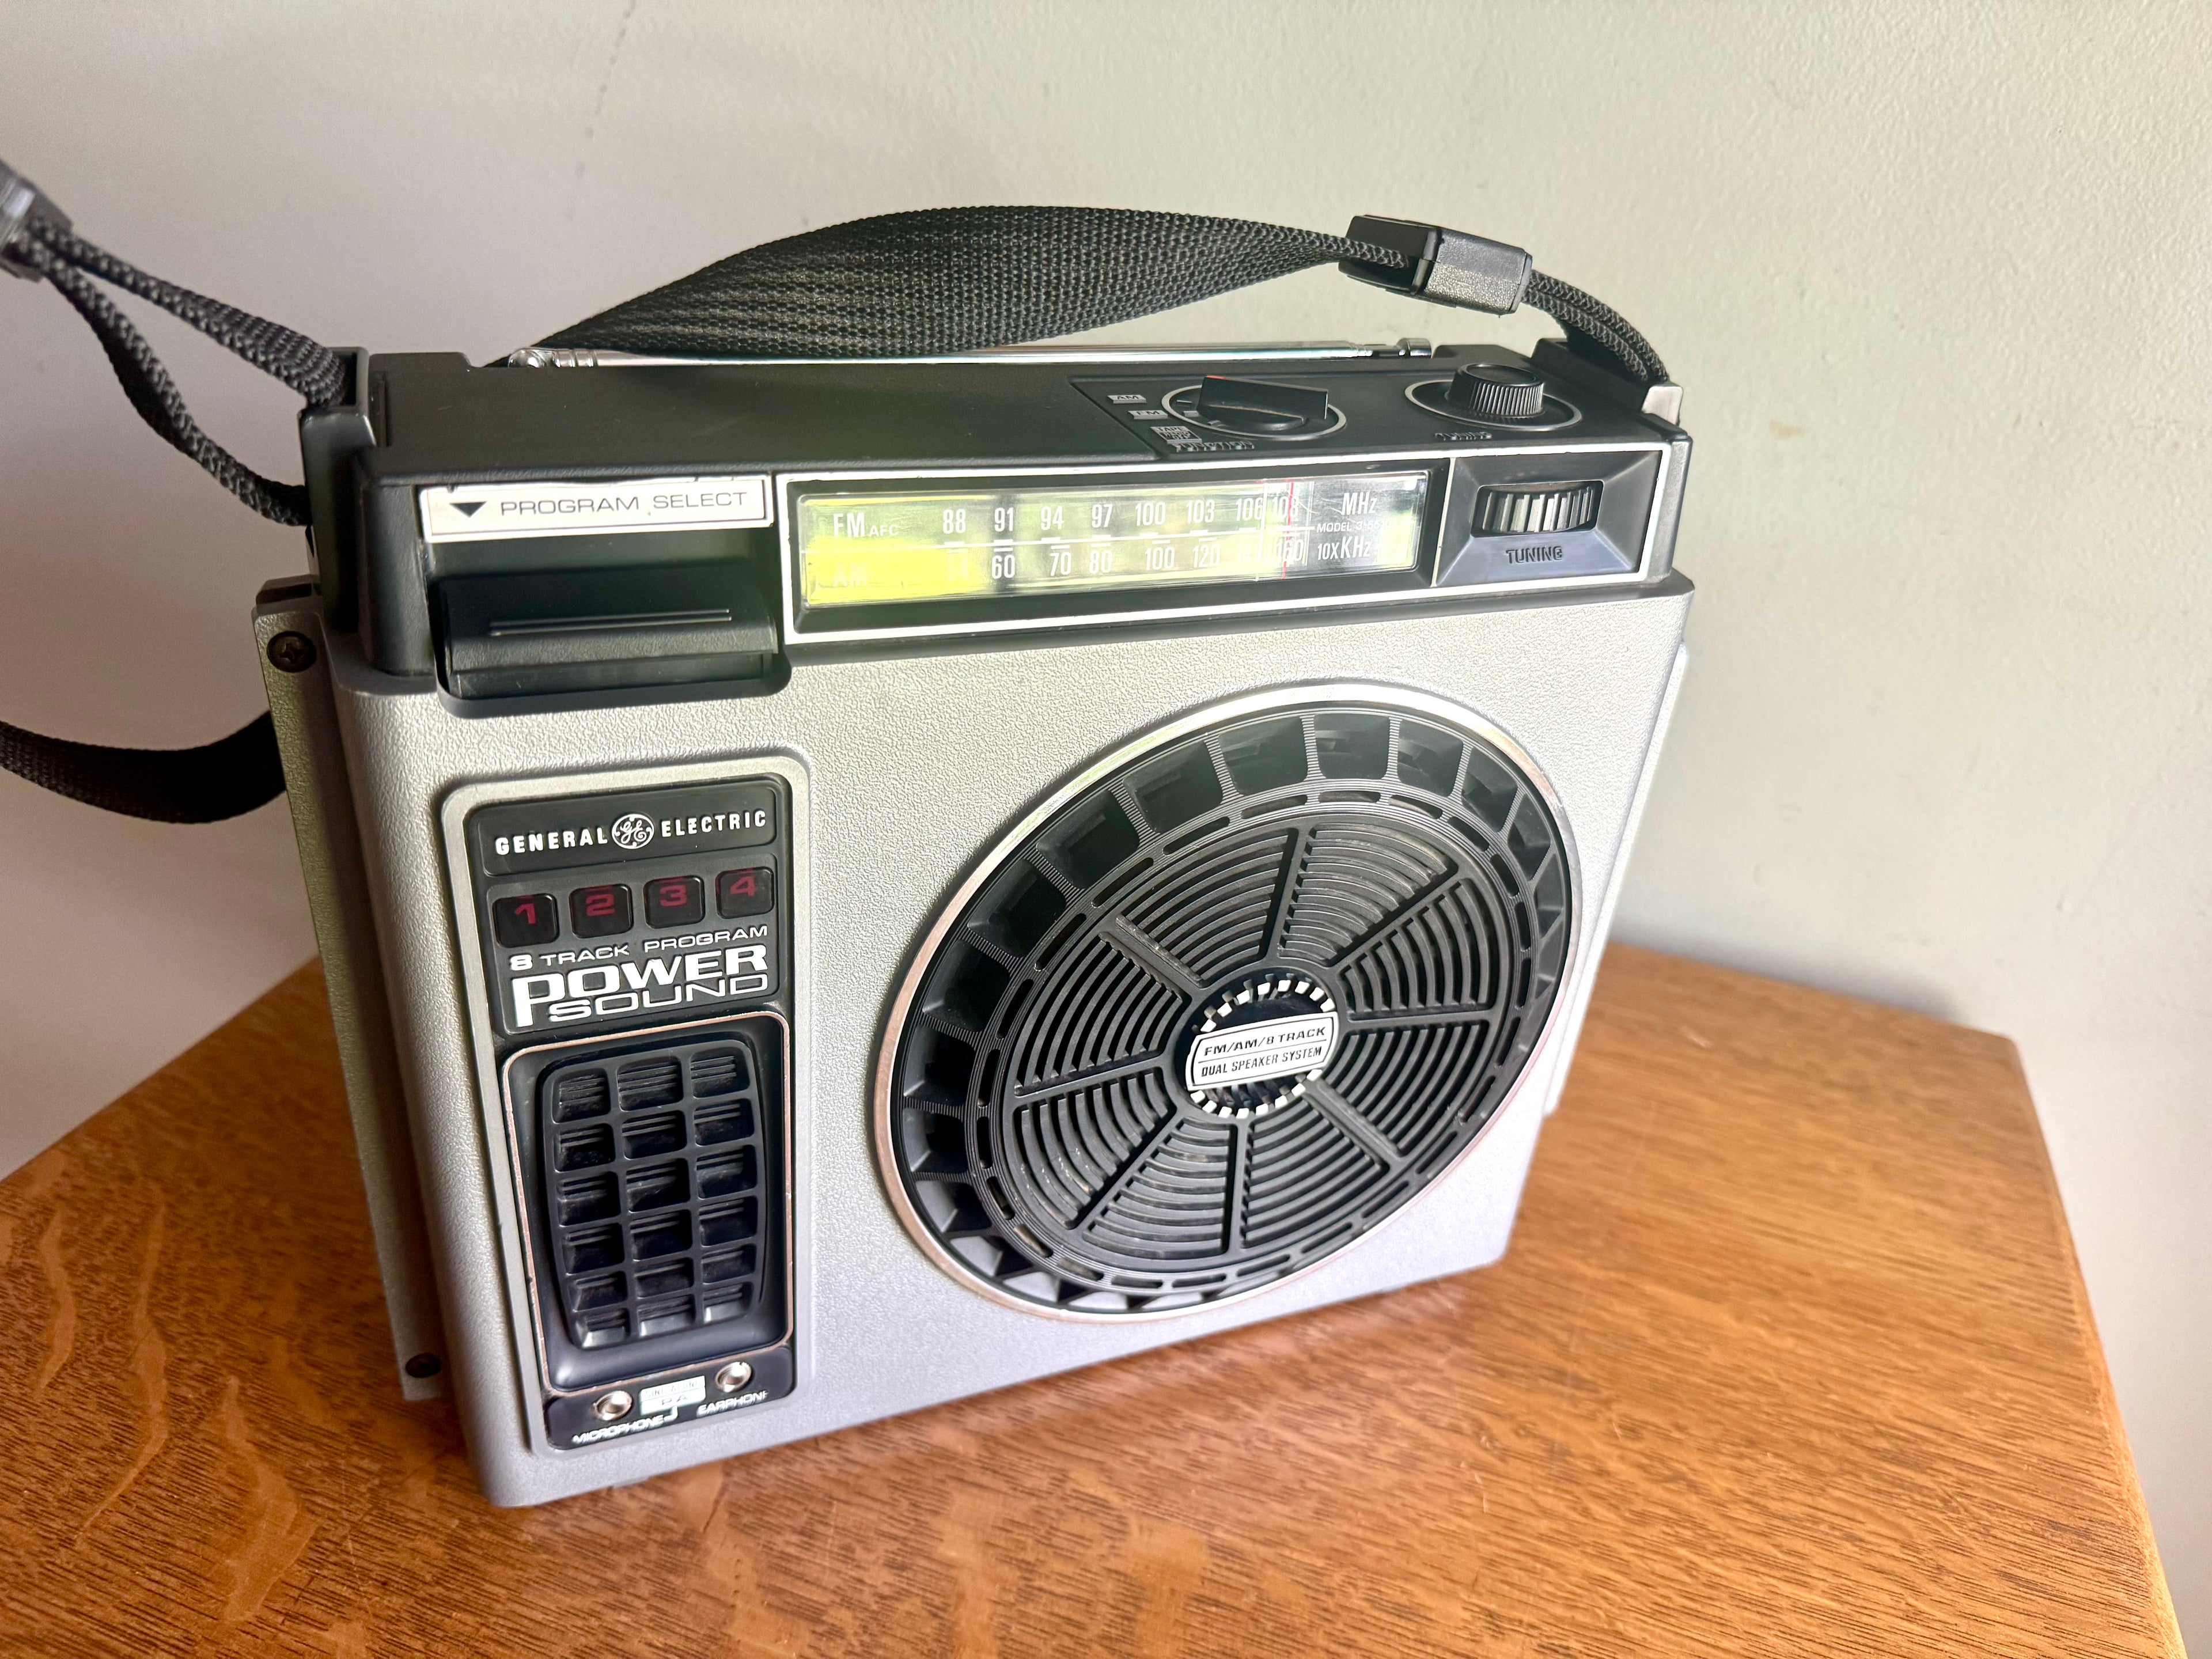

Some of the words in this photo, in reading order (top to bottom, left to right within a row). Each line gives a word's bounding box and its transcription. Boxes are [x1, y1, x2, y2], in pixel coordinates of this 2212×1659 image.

[501, 497, 639, 516] PROGRAM
[653, 491, 748, 510] SELECT
[833, 512, 865, 538] FM
[869, 524, 899, 537] AFC
[942, 509, 966, 535] 88
[994, 507, 1014, 532] 91
[1040, 506, 1064, 530] 94
[1092, 504, 1113, 528] 97
[1135, 501, 1166, 526] 100
[1187, 499, 1215, 524] 103
[1236, 497, 1263, 521] 106
[1272, 495, 1300, 518] 108
[1342, 492, 1377, 516] MHz
[1316, 522, 1352, 533] MODEL
[991, 554, 1016, 579] 60
[1050, 551, 1072, 576] 70
[1089, 550, 1112, 574] 80
[1145, 547, 1175, 570] 100
[1192, 544, 1221, 568] 120
[1505, 546, 1563, 564] TUNING
[495, 827, 608, 856] GENERAL
[661, 810, 767, 838] ELECTRIC
[514, 904, 536, 925] 1
[585, 893, 616, 918] 2
[660, 884, 687, 907] 3
[729, 876, 759, 897] 4
[509, 953, 533, 971] 8
[540, 944, 630, 967] TRACK
[644, 926, 768, 952] PROGRAM
[548, 974, 769, 1022] SOUND
[1204, 1036, 1274, 1056] FM/AM/8
[1278, 1027, 1326, 1042] TRACK
[1201, 1063, 1228, 1077] DUAL
[1232, 1054, 1278, 1071] SPEAKER
[1282, 1046, 1322, 1062] SYSTEM
[572, 1415, 664, 1445] MICROPHONE
